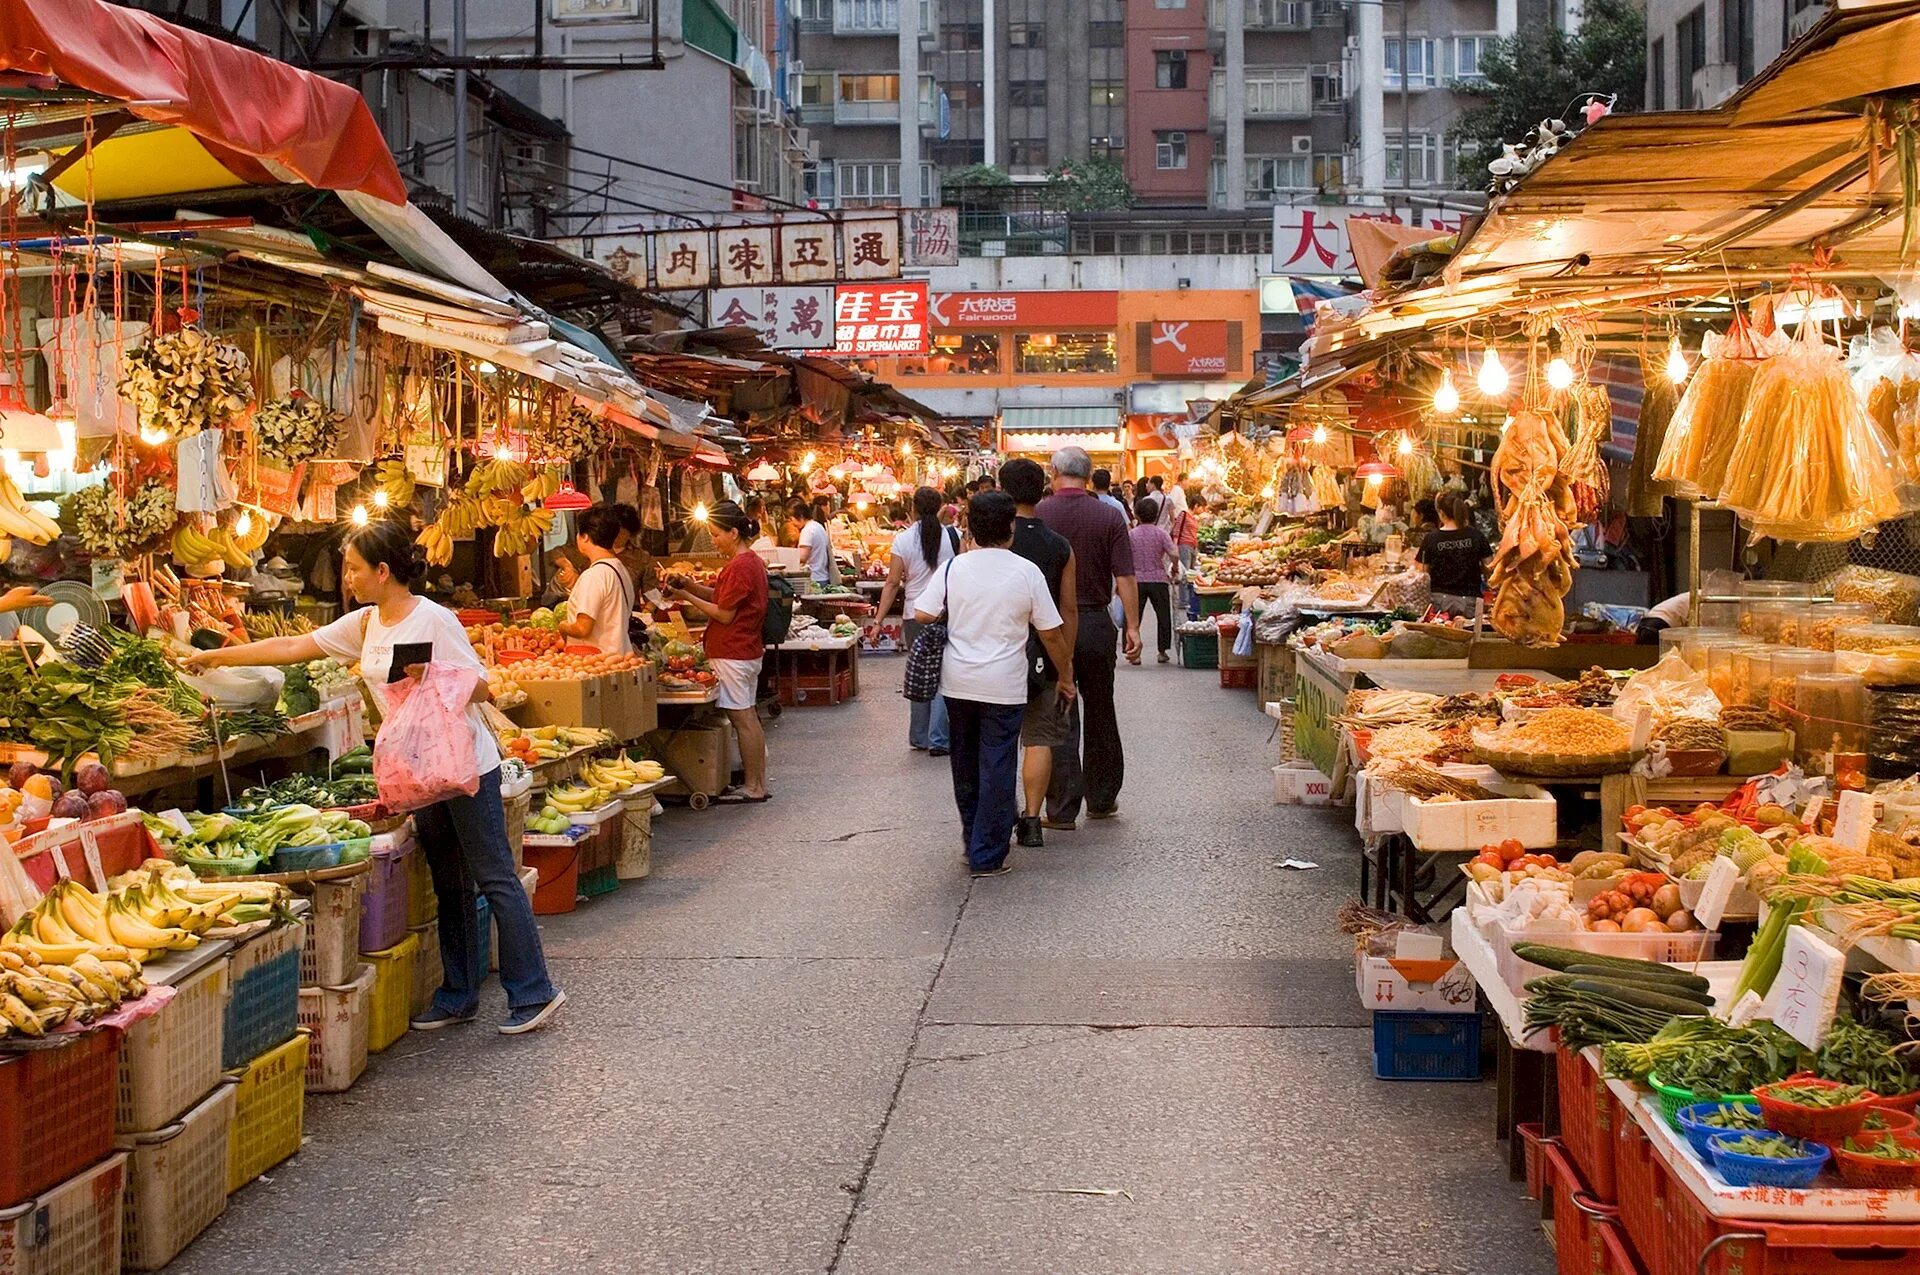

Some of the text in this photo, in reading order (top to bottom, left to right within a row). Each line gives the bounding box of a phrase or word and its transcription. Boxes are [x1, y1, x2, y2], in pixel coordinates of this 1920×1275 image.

[958, 297, 1017, 314] 大快活
[958, 313, 1017, 322] Fairwood
[856, 339, 922, 352] SUPERMARKET
[1187, 357, 1226, 368] 大快活
[1306, 782, 1328, 795] XXL
